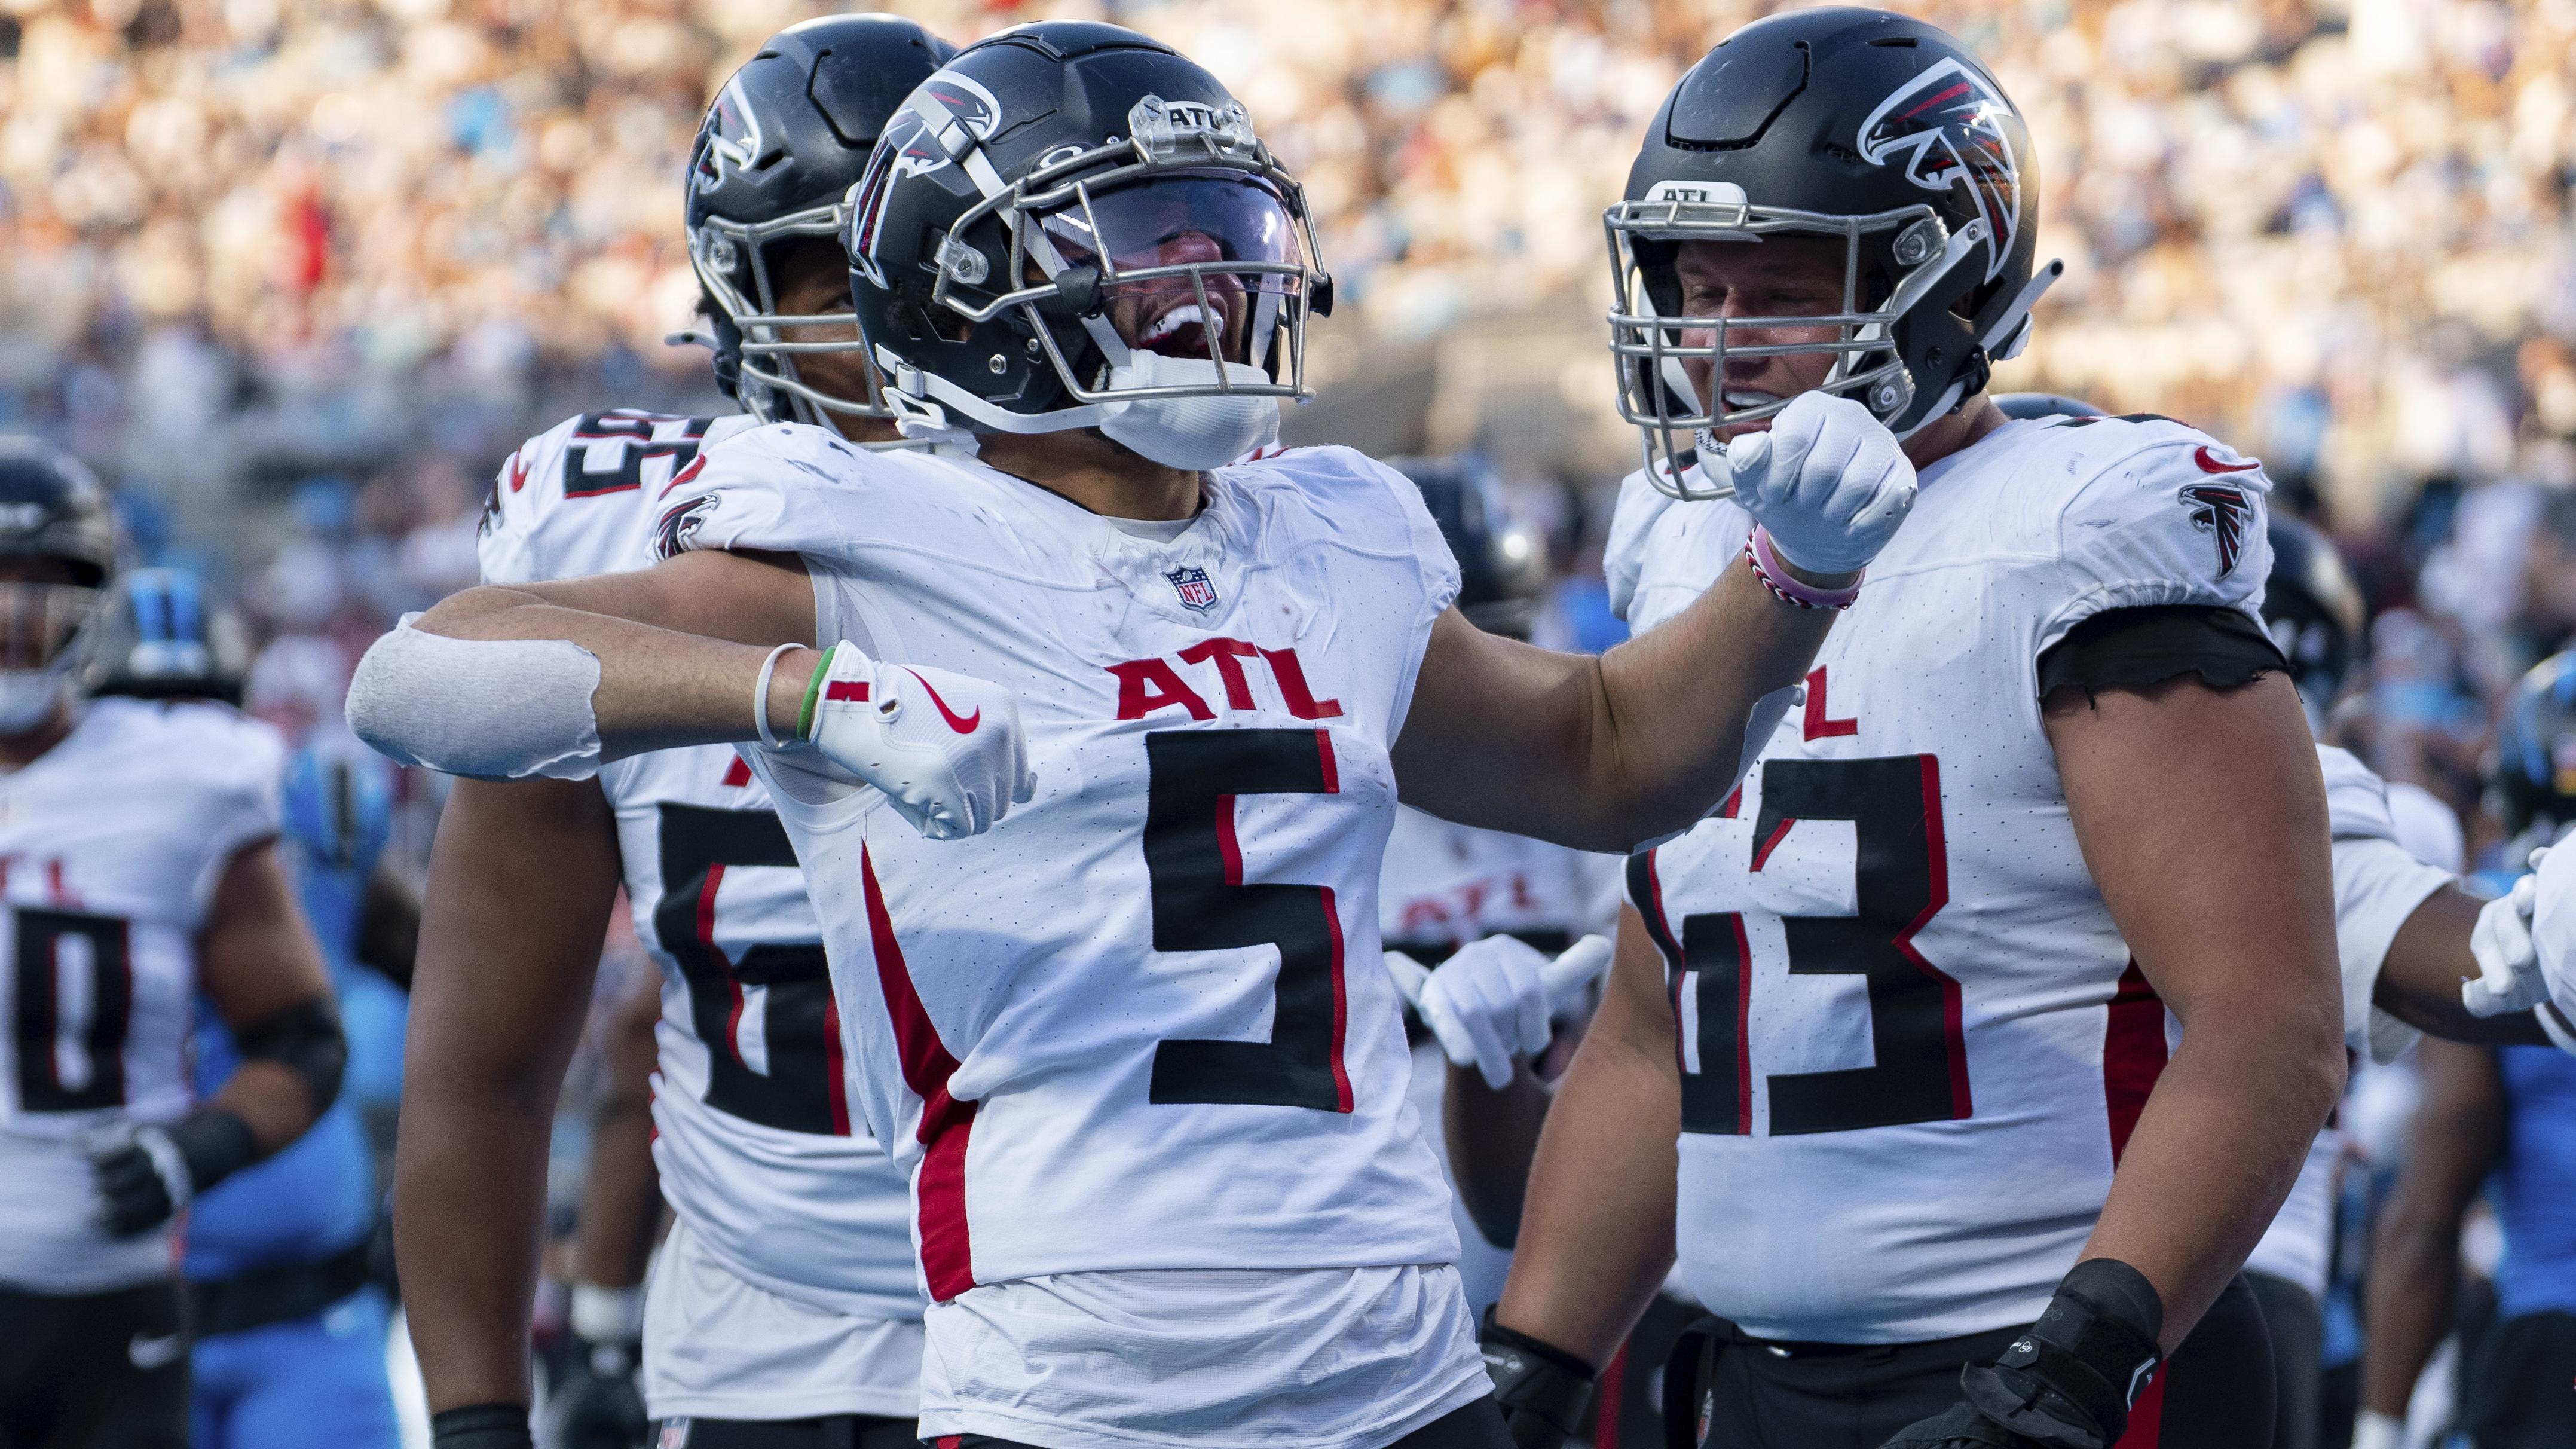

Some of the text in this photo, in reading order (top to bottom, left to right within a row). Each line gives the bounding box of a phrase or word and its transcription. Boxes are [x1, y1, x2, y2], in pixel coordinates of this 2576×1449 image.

[1168, 107, 1221, 130] ATL
[1104, 637, 1344, 720] ATL
[1179, 582, 1213, 604] NFL
[653, 802, 873, 1139] 6
[1143, 728, 1354, 1113] 5
[1625, 752, 1974, 1136] 63
